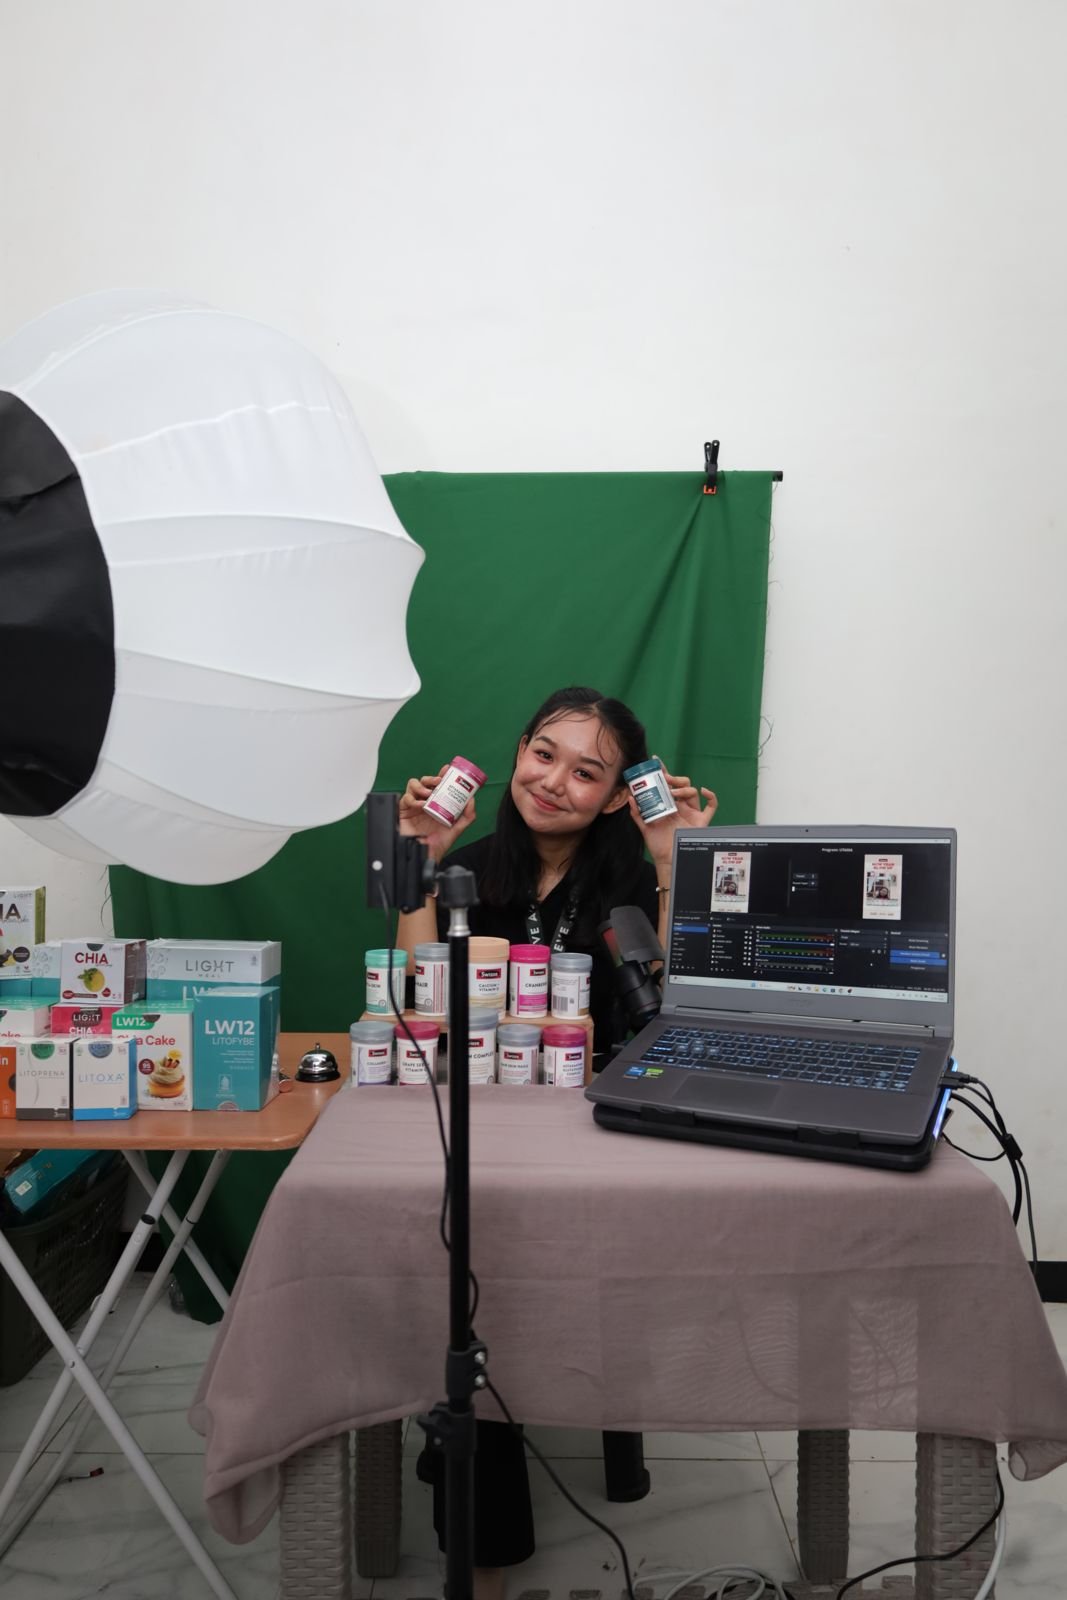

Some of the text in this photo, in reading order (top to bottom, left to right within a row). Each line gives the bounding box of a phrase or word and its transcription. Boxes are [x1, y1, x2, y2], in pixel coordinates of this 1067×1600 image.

[74, 952, 109, 965] CHIA
[185, 959, 235, 973] LIGHT
[73, 1014, 101, 1022] LIGHT
[116, 1017, 147, 1027] LW12
[204, 1020, 255, 1035] LW12
[149, 1035, 176, 1046] Cake
[212, 1037, 255, 1046] LITOFYBE
[78, 1073, 123, 1083] LITOXA
